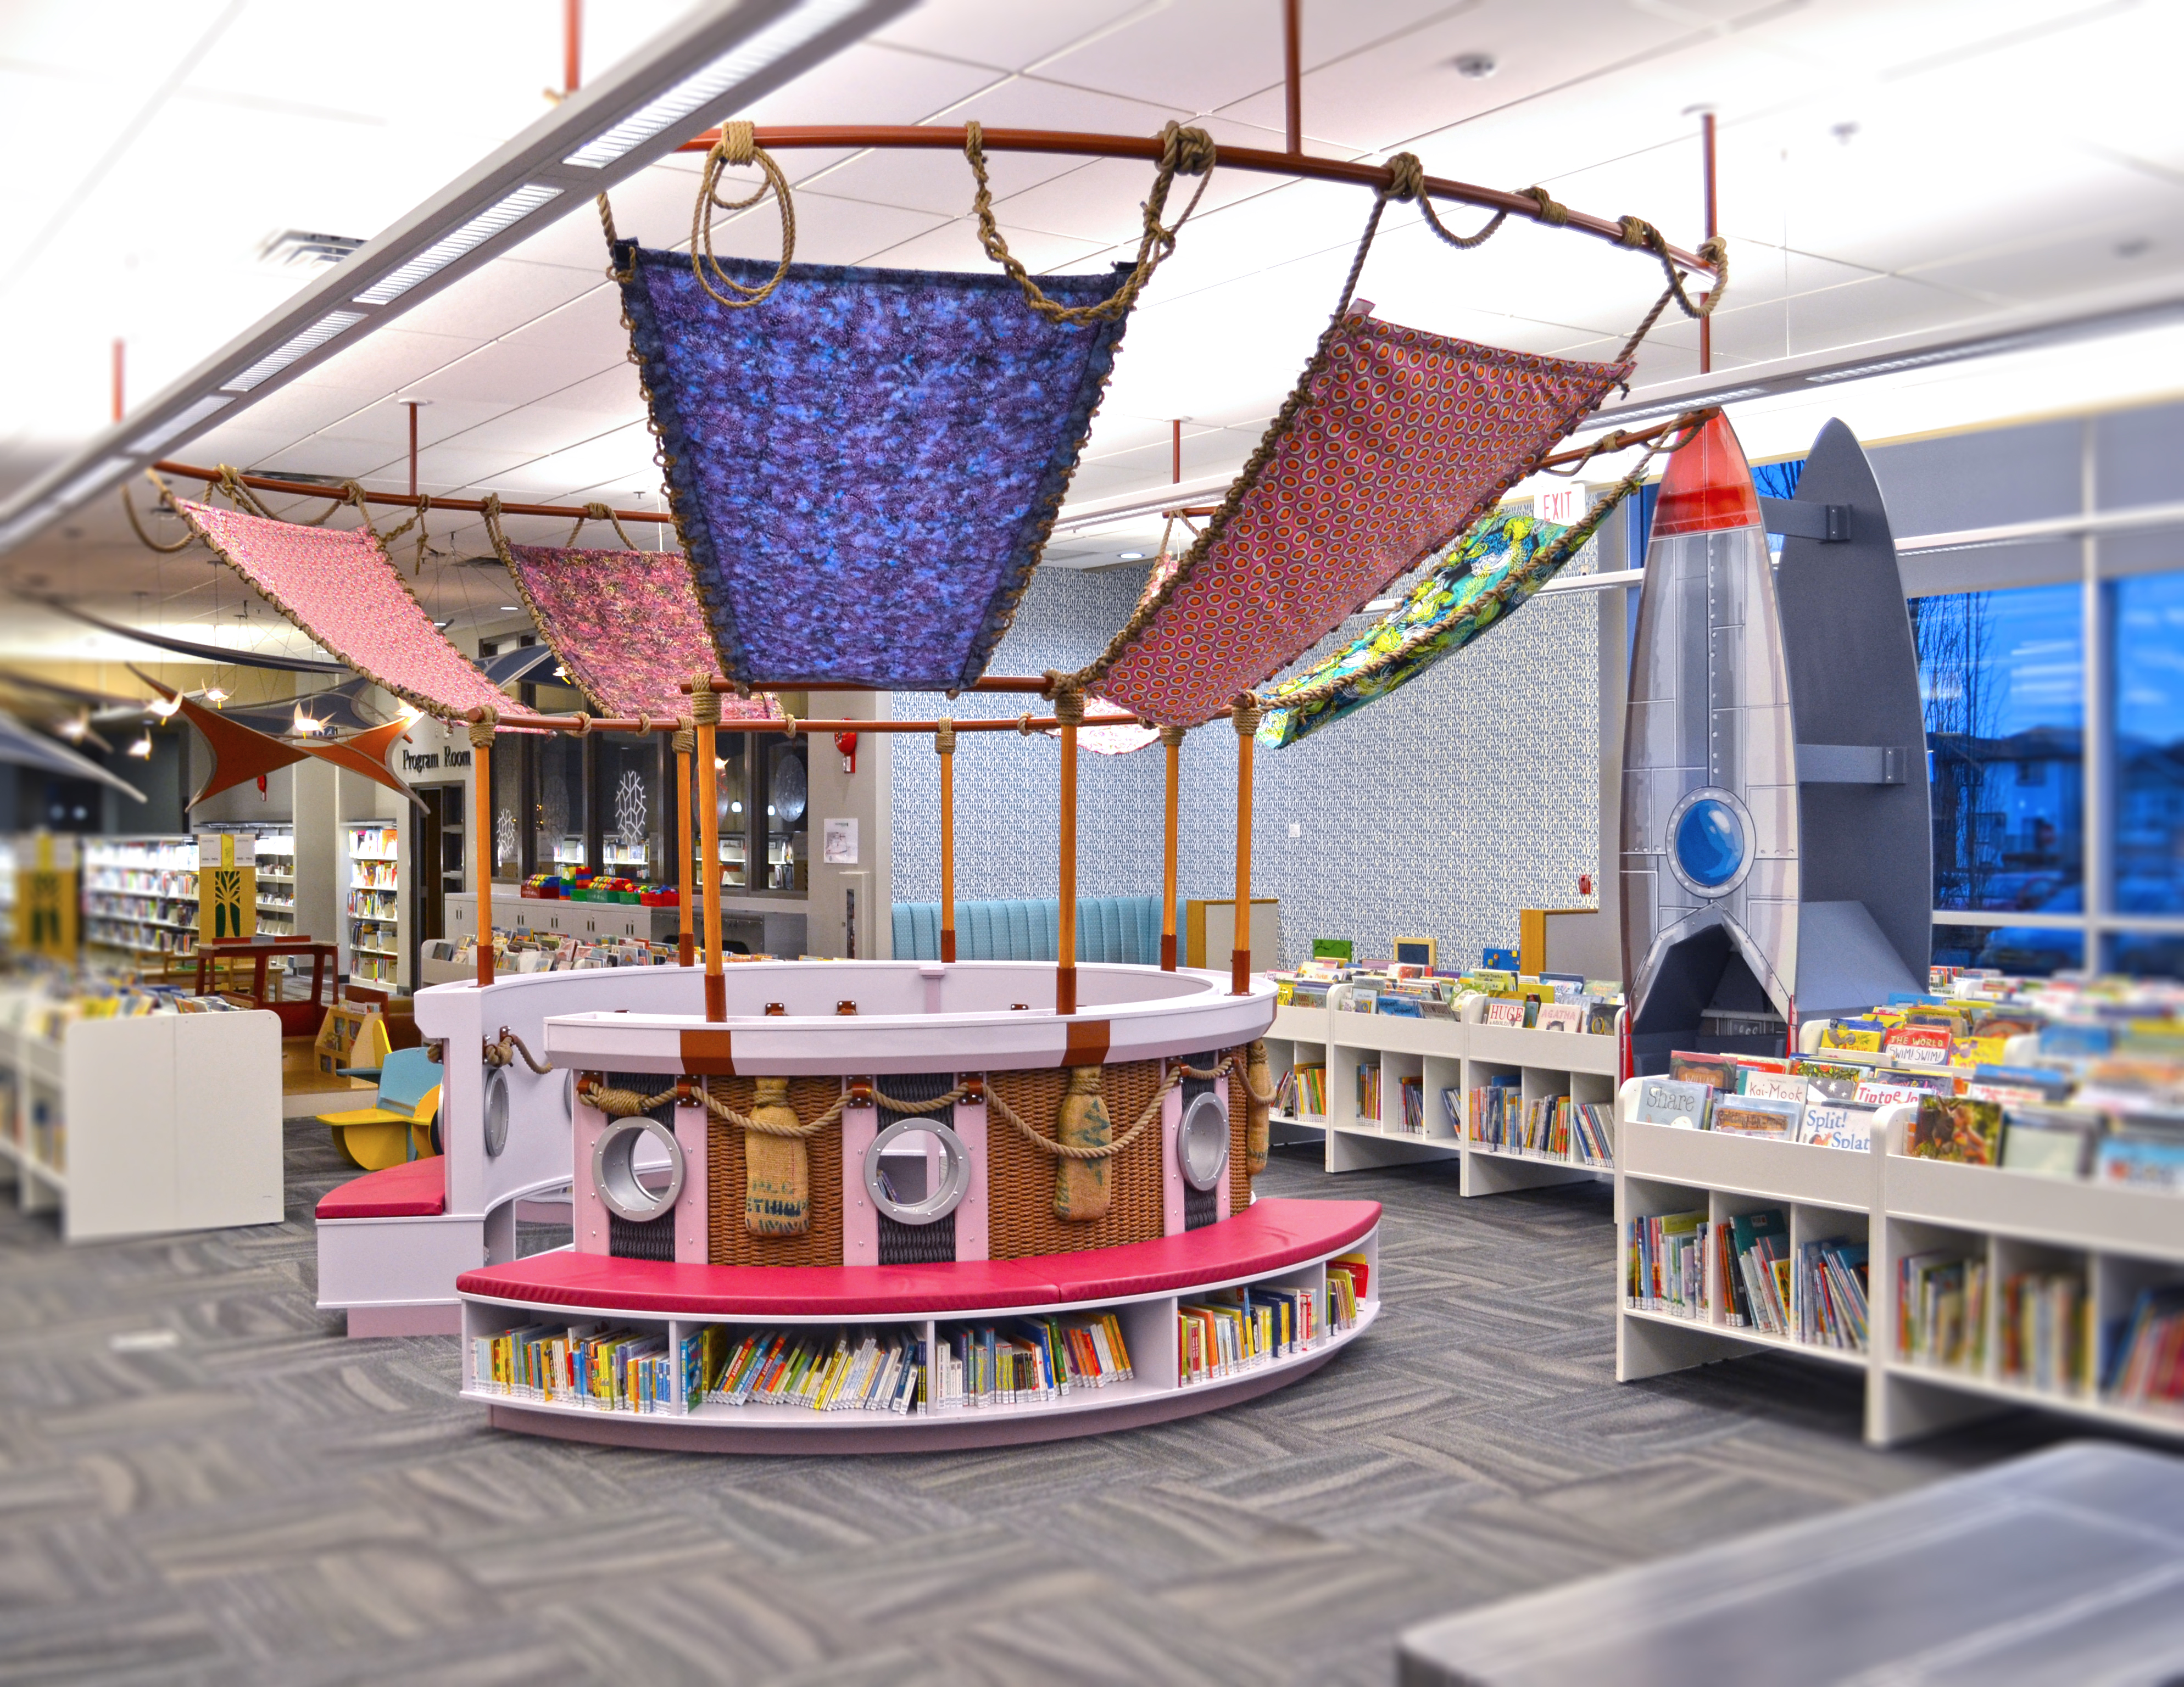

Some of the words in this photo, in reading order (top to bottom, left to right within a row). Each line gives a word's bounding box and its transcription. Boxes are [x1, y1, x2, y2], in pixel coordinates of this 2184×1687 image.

[1544, 491, 1572, 522] EXIT
[403, 749, 439, 773] Program
[444, 745, 471, 767] Room
[1490, 1005, 1523, 1021] HUGE
[1542, 1009, 1575, 1021] AGATHA
[1891, 1036, 1908, 1045] THE
[1912, 1037, 1943, 1047] WORLD
[1890, 1047, 1913, 1060] SWIM!
[1915, 1048, 1941, 1062] SWIM!
[1685, 1073, 1715, 1086] WILLIAM
[1646, 1086, 1695, 1112] Share
[1750, 1082, 1803, 1102] Kai-Mook
[1858, 1087, 1901, 1104] Tiptoe
[1807, 1109, 1847, 1134] Split!
[1831, 1132, 1870, 1150] Splat
[740, 1349, 748, 1360] THE
[771, 1348, 779, 1359] THE
[732, 1359, 743, 1377] NOISY
[762, 1358, 773, 1376] NOISY
